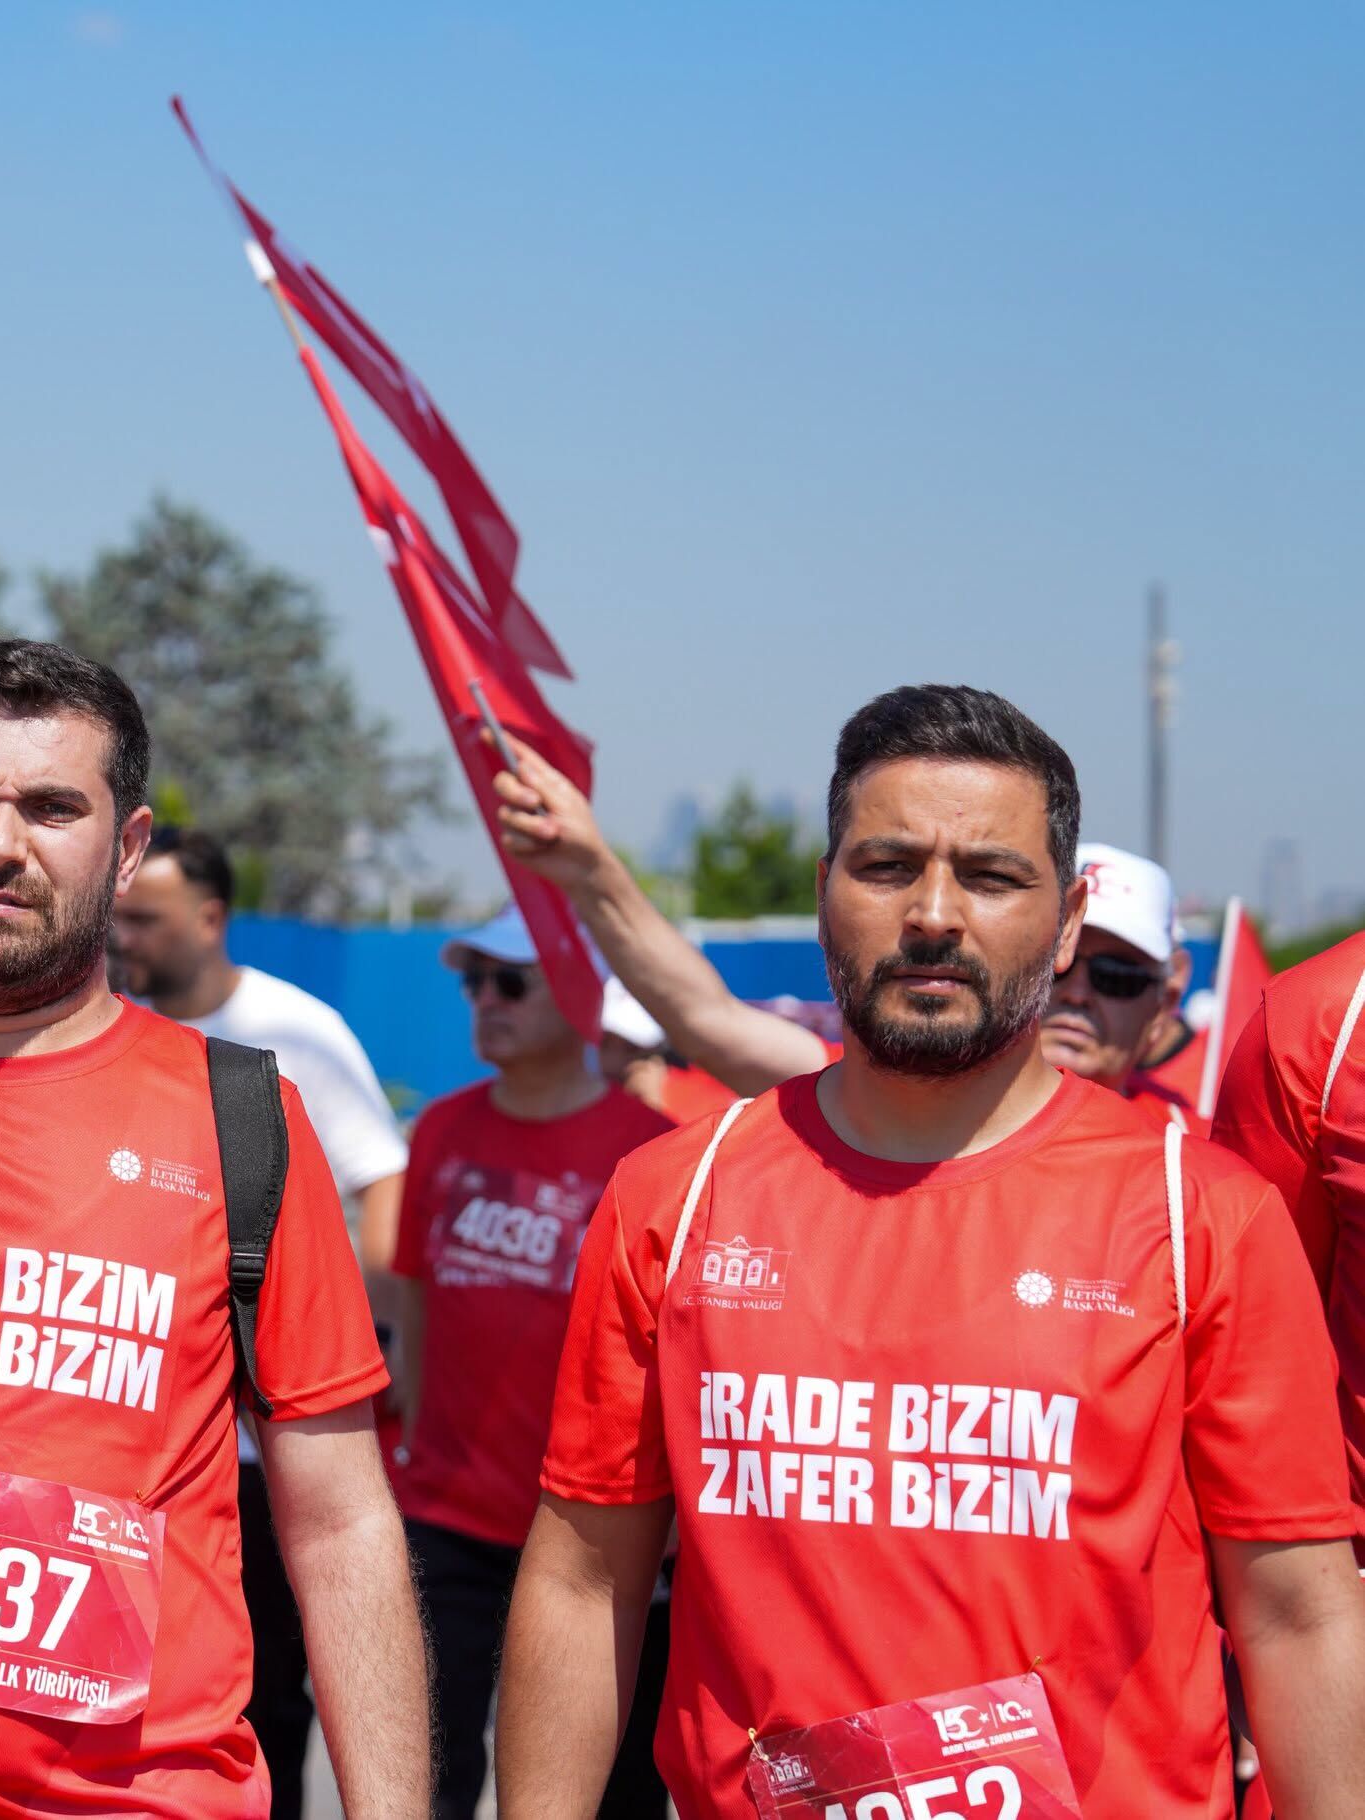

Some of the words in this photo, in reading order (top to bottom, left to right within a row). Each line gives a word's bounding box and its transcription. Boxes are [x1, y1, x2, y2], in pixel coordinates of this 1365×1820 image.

[0, 1246, 177, 1341] BİZİM
[700, 1371, 876, 1450] İRADE
[887, 1383, 1080, 1466] BİZİM
[698, 1447, 875, 1526] ZAFER
[890, 1460, 1073, 1541] BİZİM
[25, 1664, 111, 1709] YÜRÜYÜŞÜ
